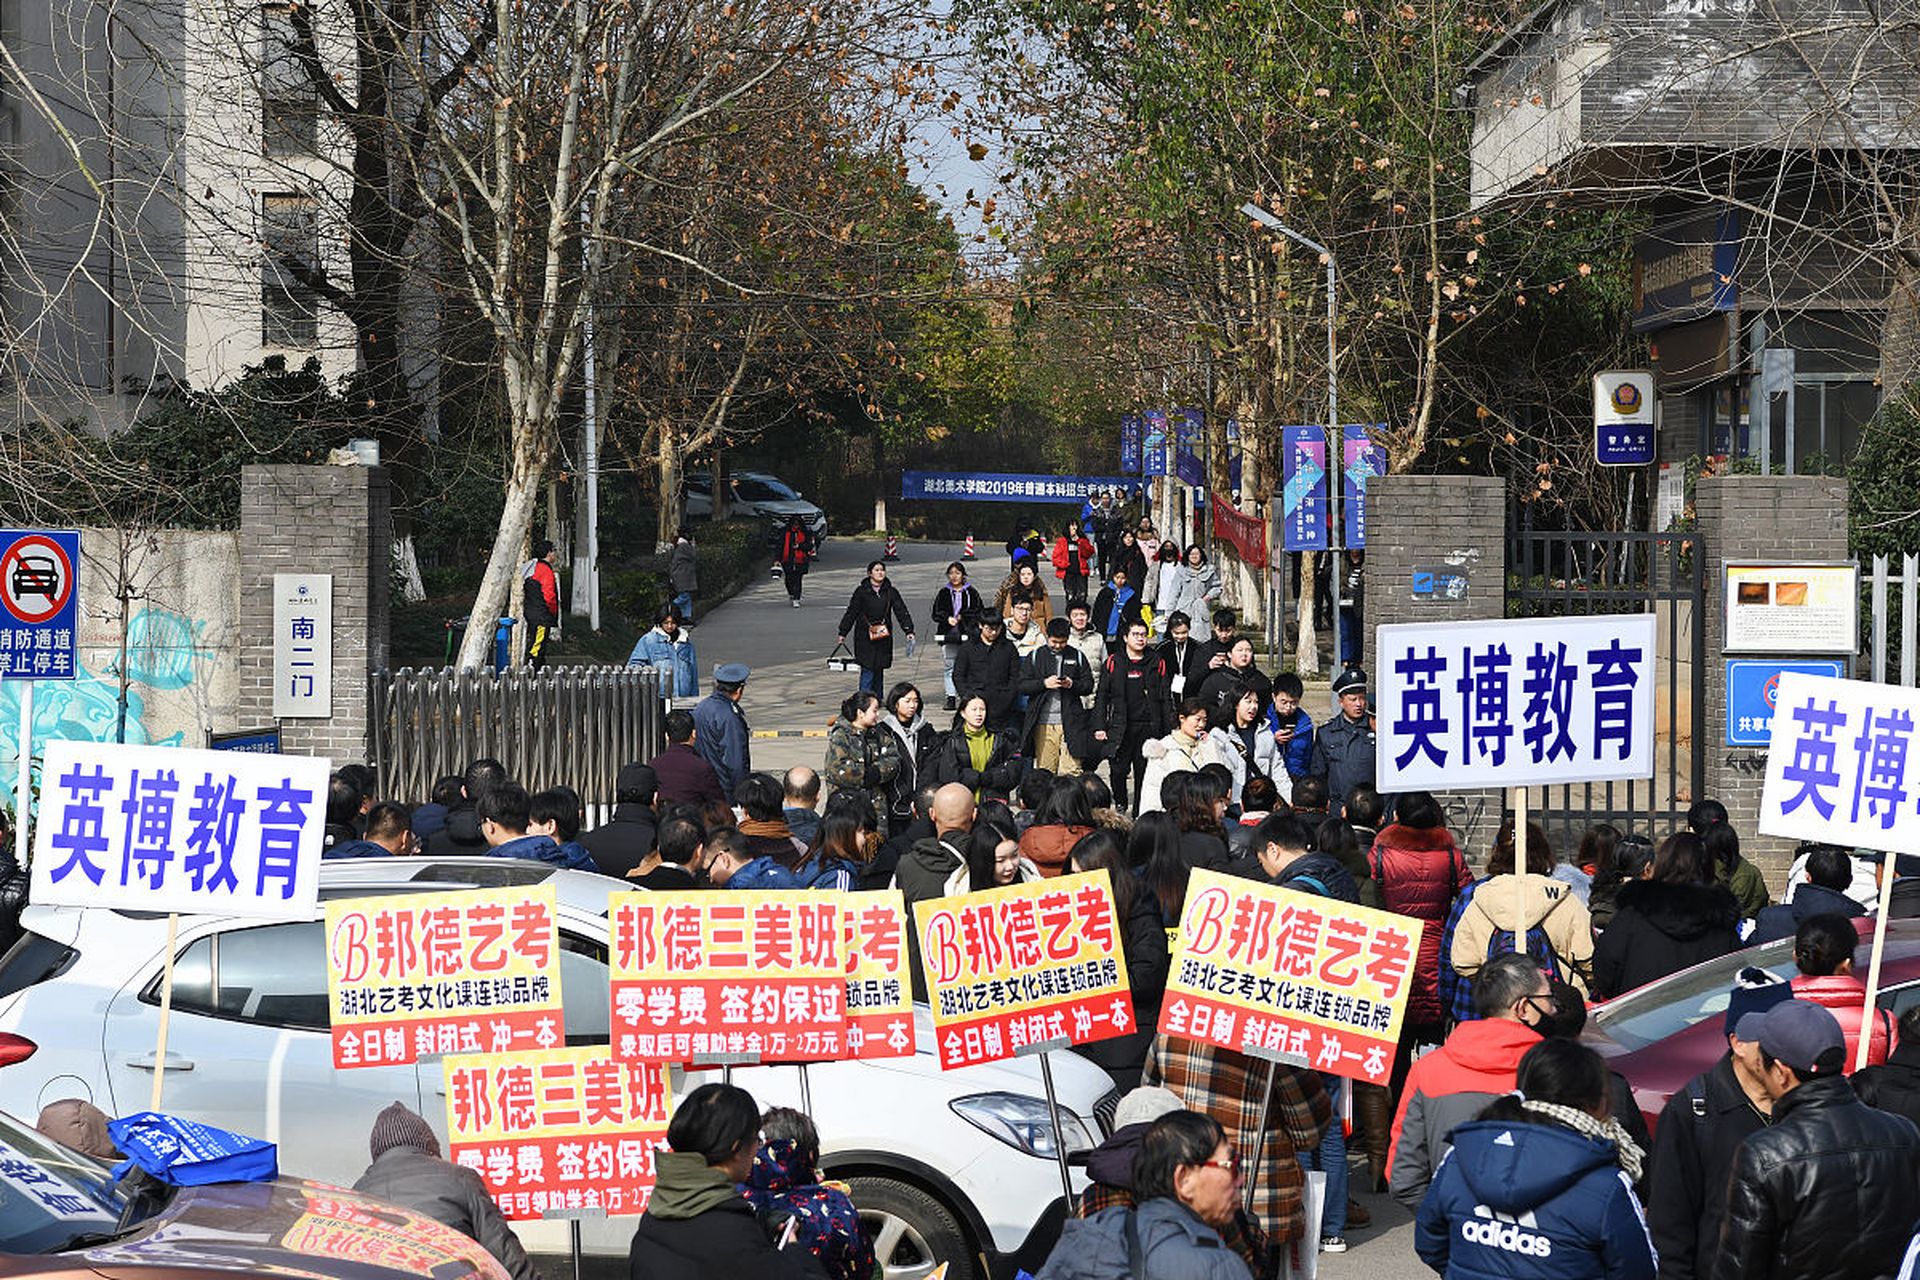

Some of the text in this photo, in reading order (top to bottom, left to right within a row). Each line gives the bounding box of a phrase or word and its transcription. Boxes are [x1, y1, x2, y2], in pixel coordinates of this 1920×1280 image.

[0, 628, 71, 650] 消防通道
[0, 652, 70, 674] 禁止停车
[291, 616, 315, 698] 南二门
[1393, 637, 1643, 772] 英博教育
[1780, 697, 1920, 830] 英博
[50, 762, 313, 900] 英博教育
[1545, 886, 1560, 900] W
[375, 900, 551, 978] 邦德艺考
[616, 903, 838, 971] 邦德三美班
[960, 886, 1113, 975] 邦德艺考
[1227, 894, 1412, 999] 邦德艺考
[340, 975, 549, 1016] 湖北艺考文化课连锁品牌
[615, 984, 842, 1026] 零学费 签约保过
[939, 958, 1118, 1016] 湖北艺考文化课连锁品牌
[1179, 959, 1392, 1032] 湖北艺考文化课连锁品牌
[339, 1016, 558, 1064] 全日制 封闭式 冲一本
[944, 998, 1129, 1065] 全日制 封闭式 冲一本
[1166, 999, 1388, 1079] 全日制 封闭式 冲一本
[452, 1059, 667, 1133] 邦德三美班
[456, 1144, 545, 1186] 零学费
[489, 1185, 654, 1215] 后可领助学金1万~2万
[1461, 1220, 1552, 1257] adidas
